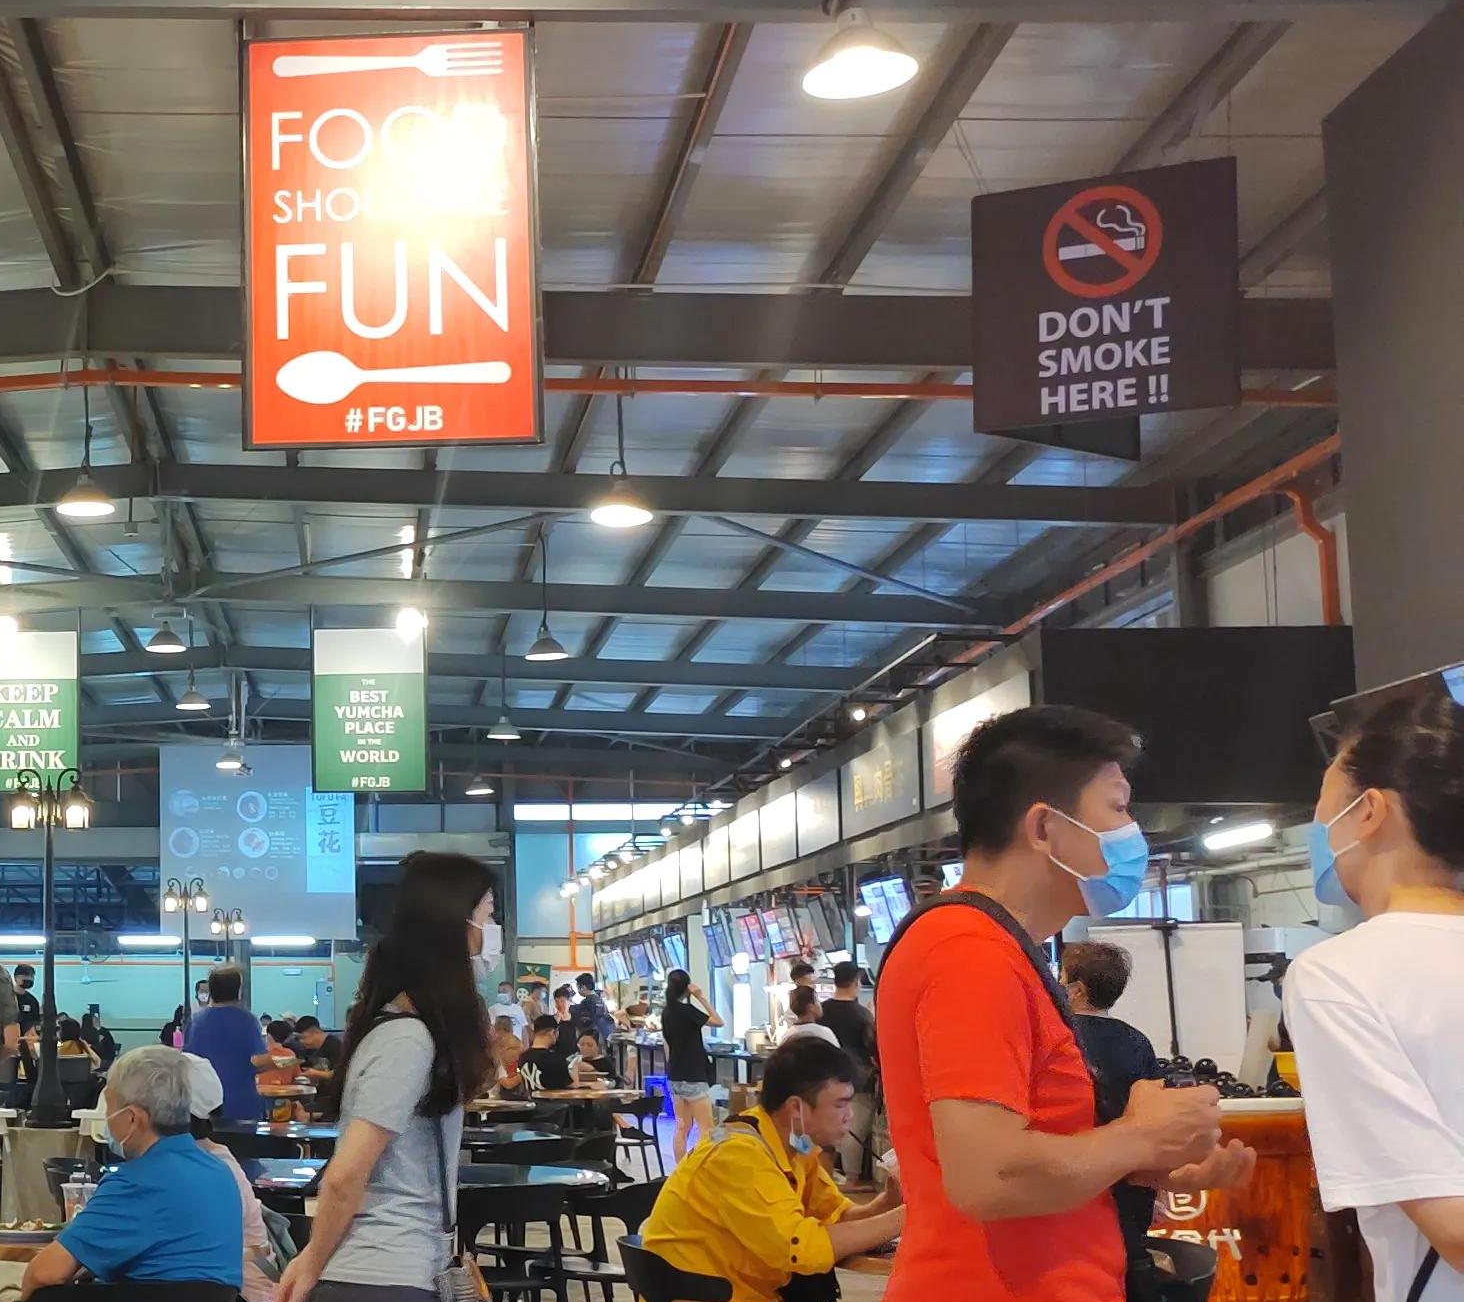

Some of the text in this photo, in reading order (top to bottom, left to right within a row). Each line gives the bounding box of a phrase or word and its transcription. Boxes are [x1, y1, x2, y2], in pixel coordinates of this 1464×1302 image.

[276, 237, 509, 340] FUN
[1038, 297, 1171, 343] DON'T
[1038, 336, 1171, 378] SMOKE
[1040, 378, 1137, 415] HERE
[345, 405, 443, 433] #FGJB
[361, 678, 376, 686] THE
[349, 690, 389, 703] BEST
[334, 705, 404, 719] YUMCHA
[344, 721, 395, 734] PLACE
[6, 734, 41, 747] AND
[357, 738, 382, 746] IN THE
[339, 750, 400, 763] WORLD
[351, 776, 391, 788] #FGJB
